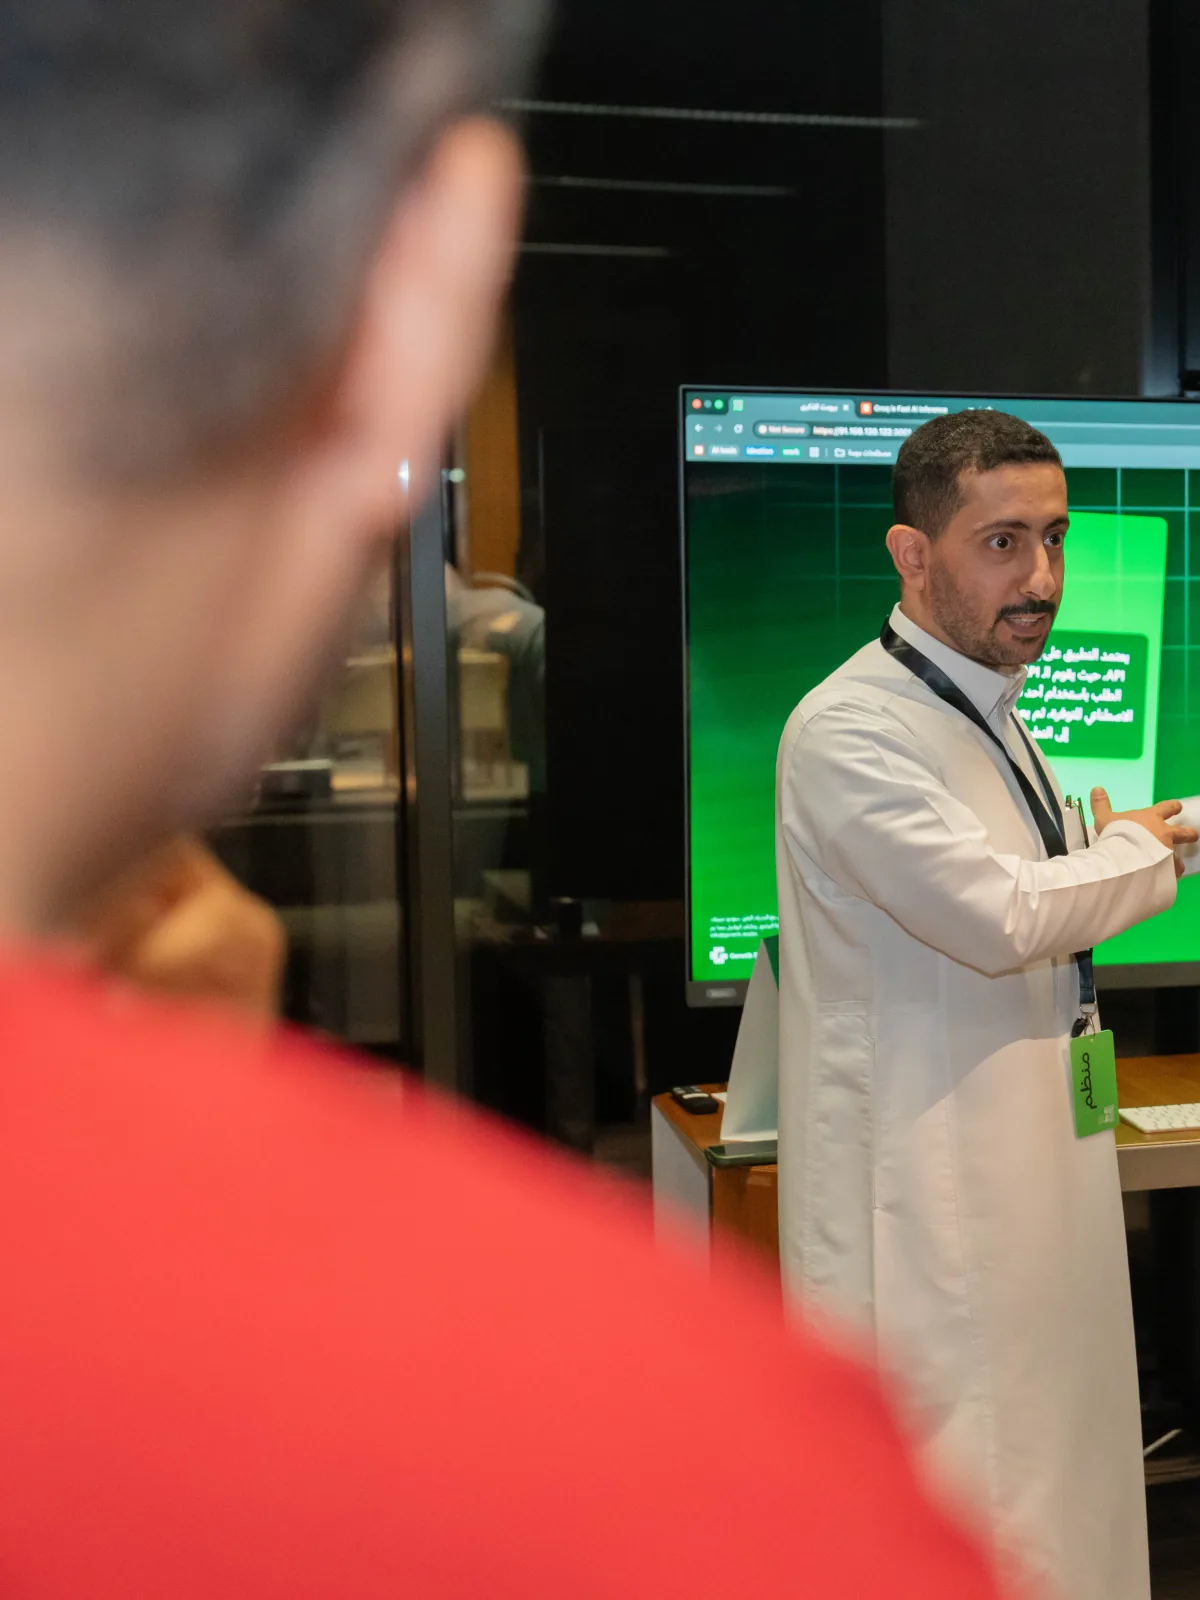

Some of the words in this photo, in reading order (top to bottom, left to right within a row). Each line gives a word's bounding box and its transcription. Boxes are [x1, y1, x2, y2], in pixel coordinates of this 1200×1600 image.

[1042, 645, 1061, 662] على
[1062, 646, 1099, 663] التطبيق
[1077, 669, 1101, 683] حيث
[1091, 688, 1122, 703] الطلب
[1080, 1052, 1097, 1110] منظم
